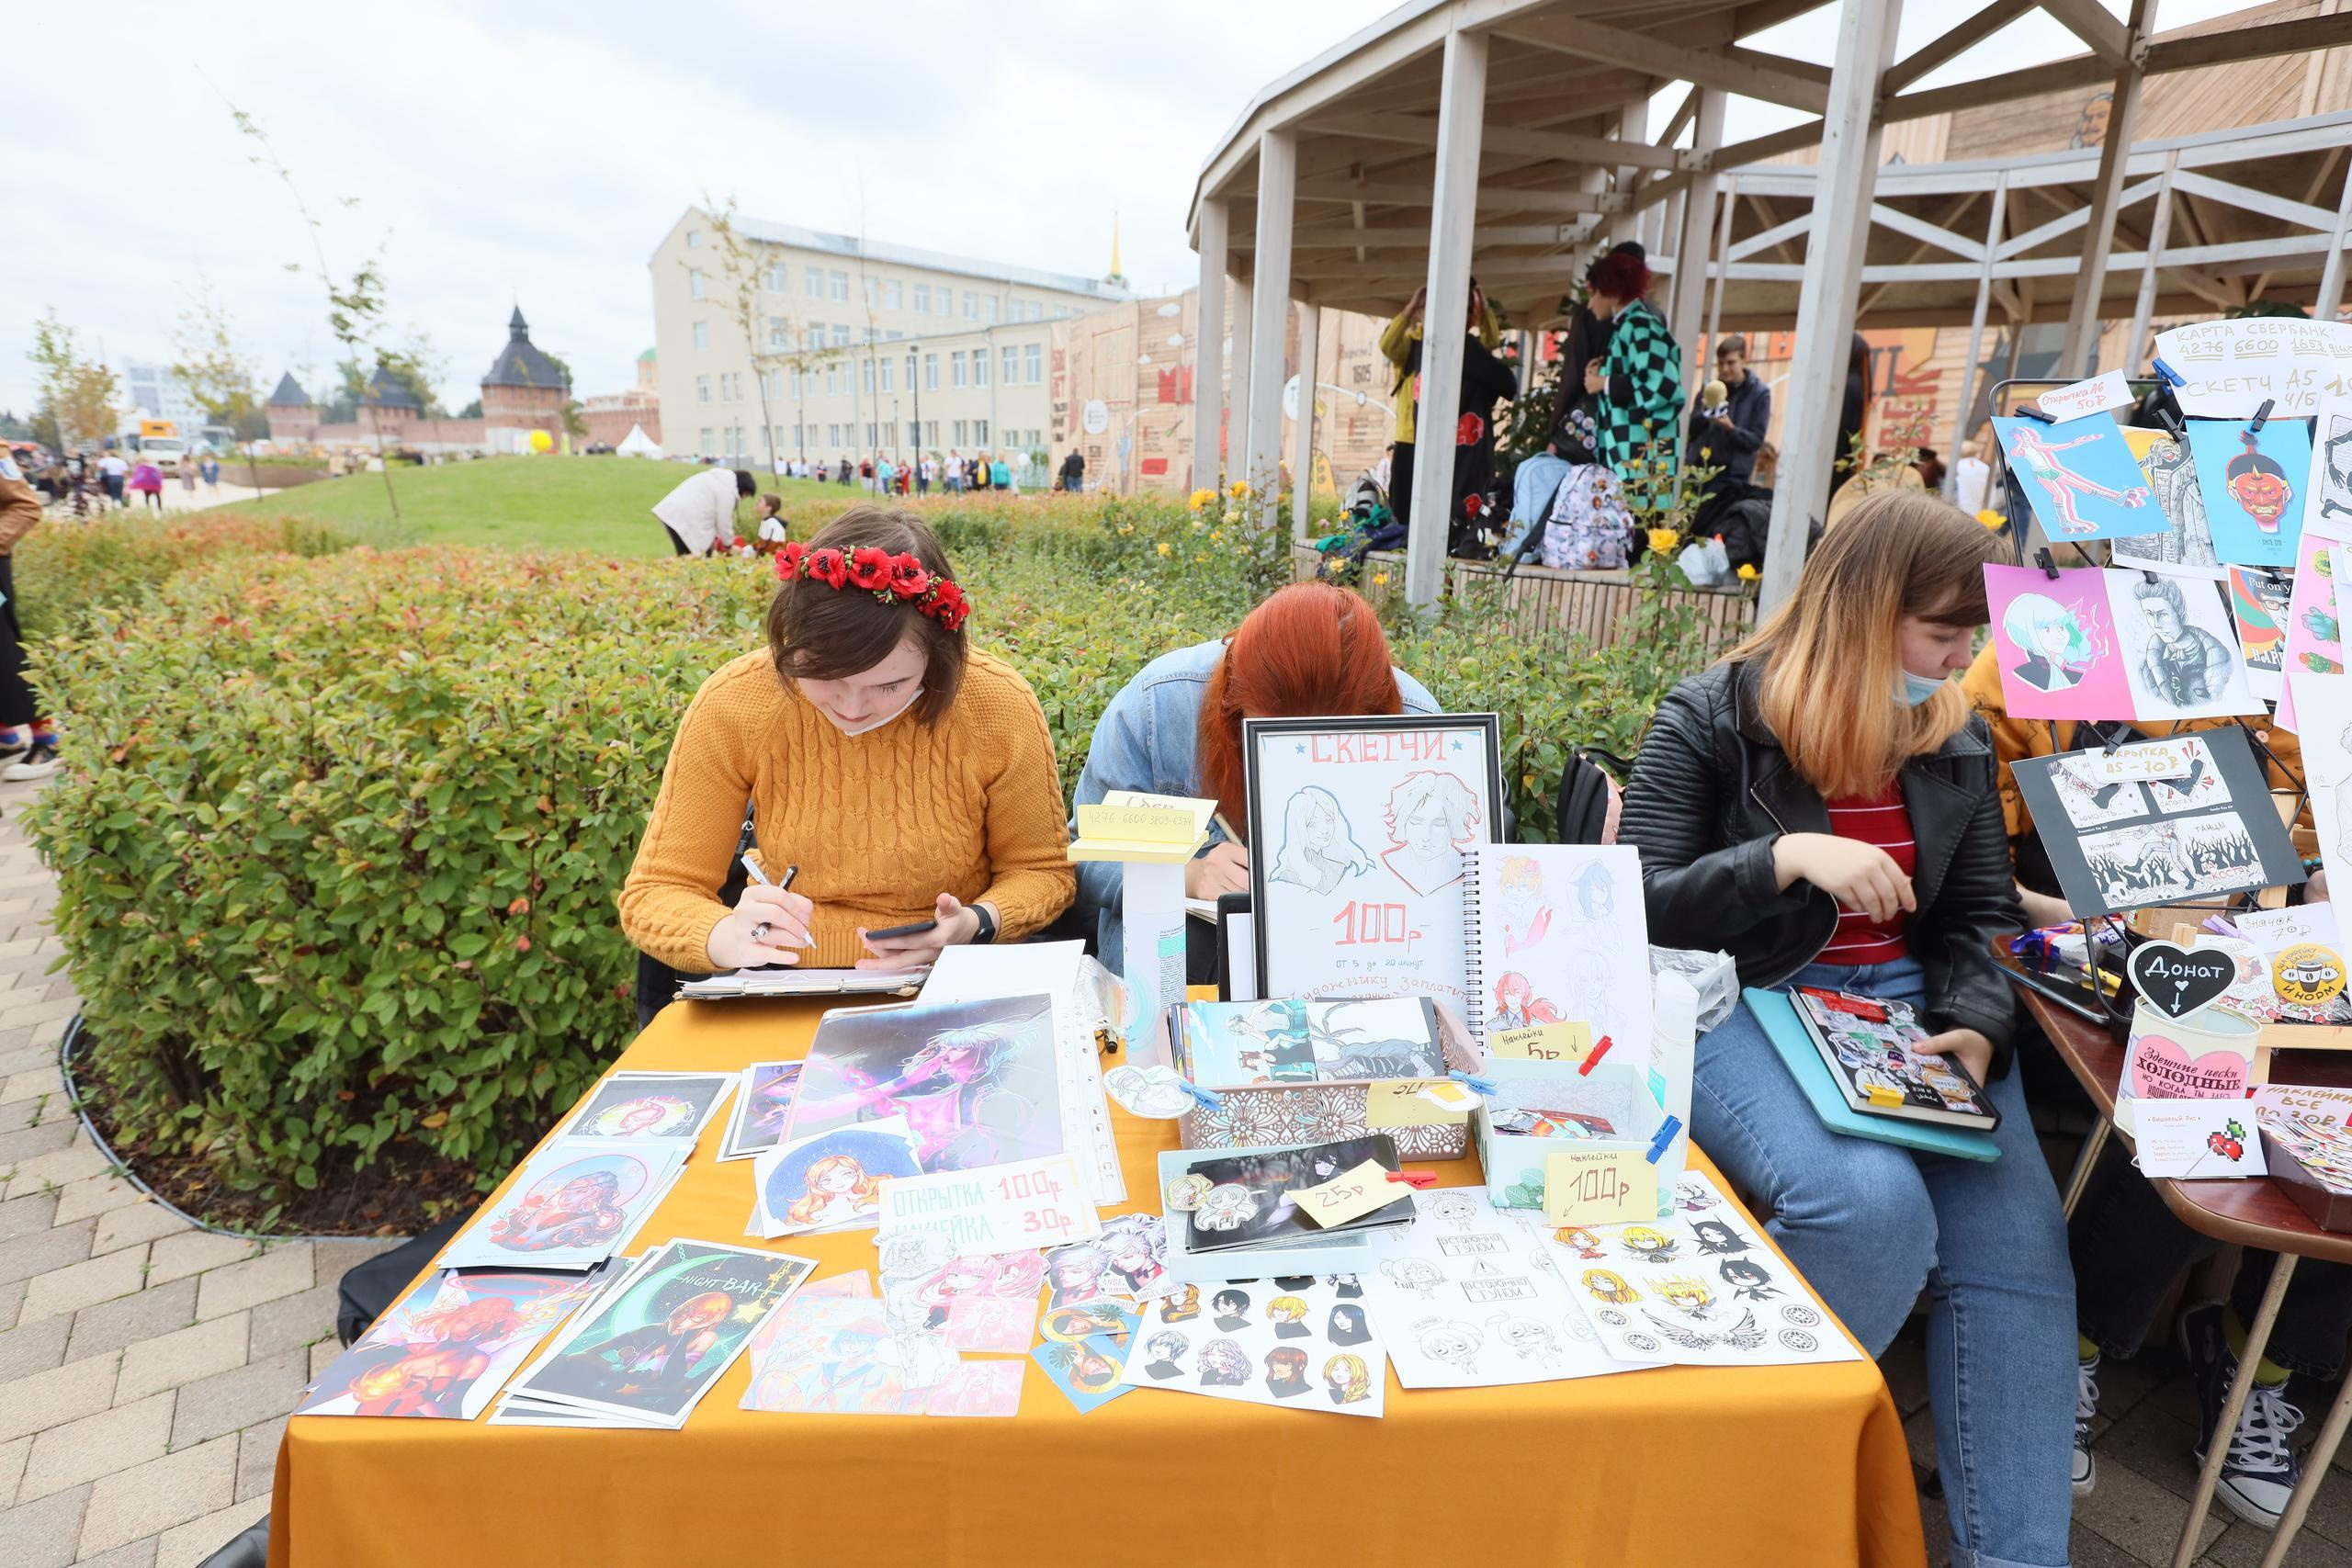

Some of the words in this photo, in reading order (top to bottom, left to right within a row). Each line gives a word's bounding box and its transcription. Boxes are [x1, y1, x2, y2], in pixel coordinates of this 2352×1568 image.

[2176, 325, 2235, 342] КАРТА
[2179, 341, 2224, 355] 4276
[2234, 339, 2279, 353] 6600
[2186, 375, 2272, 398] СКЕТЧ
[2248, 577, 2266, 590] Put
[2267, 583, 2282, 592] on
[1310, 732, 1447, 763] СКЕТЧИ
[2101, 747, 2170, 759] ОКРЫТКА
[2294, 986, 2335, 1001] НОРМ
[1501, 1029, 1544, 1045] Наклейки
[2136, 1055, 2241, 1090] ХОЛОДНЫЕ
[2142, 1073, 2153, 1082] НО
[2159, 1080, 2186, 1094] КОГДА
[1570, 1152, 1618, 1163] Наклейки
[892, 1180, 986, 1218] ОТКРЫТКА
[680, 1275, 720, 1289] NIGHT
[720, 1277, 763, 1297] BAR
